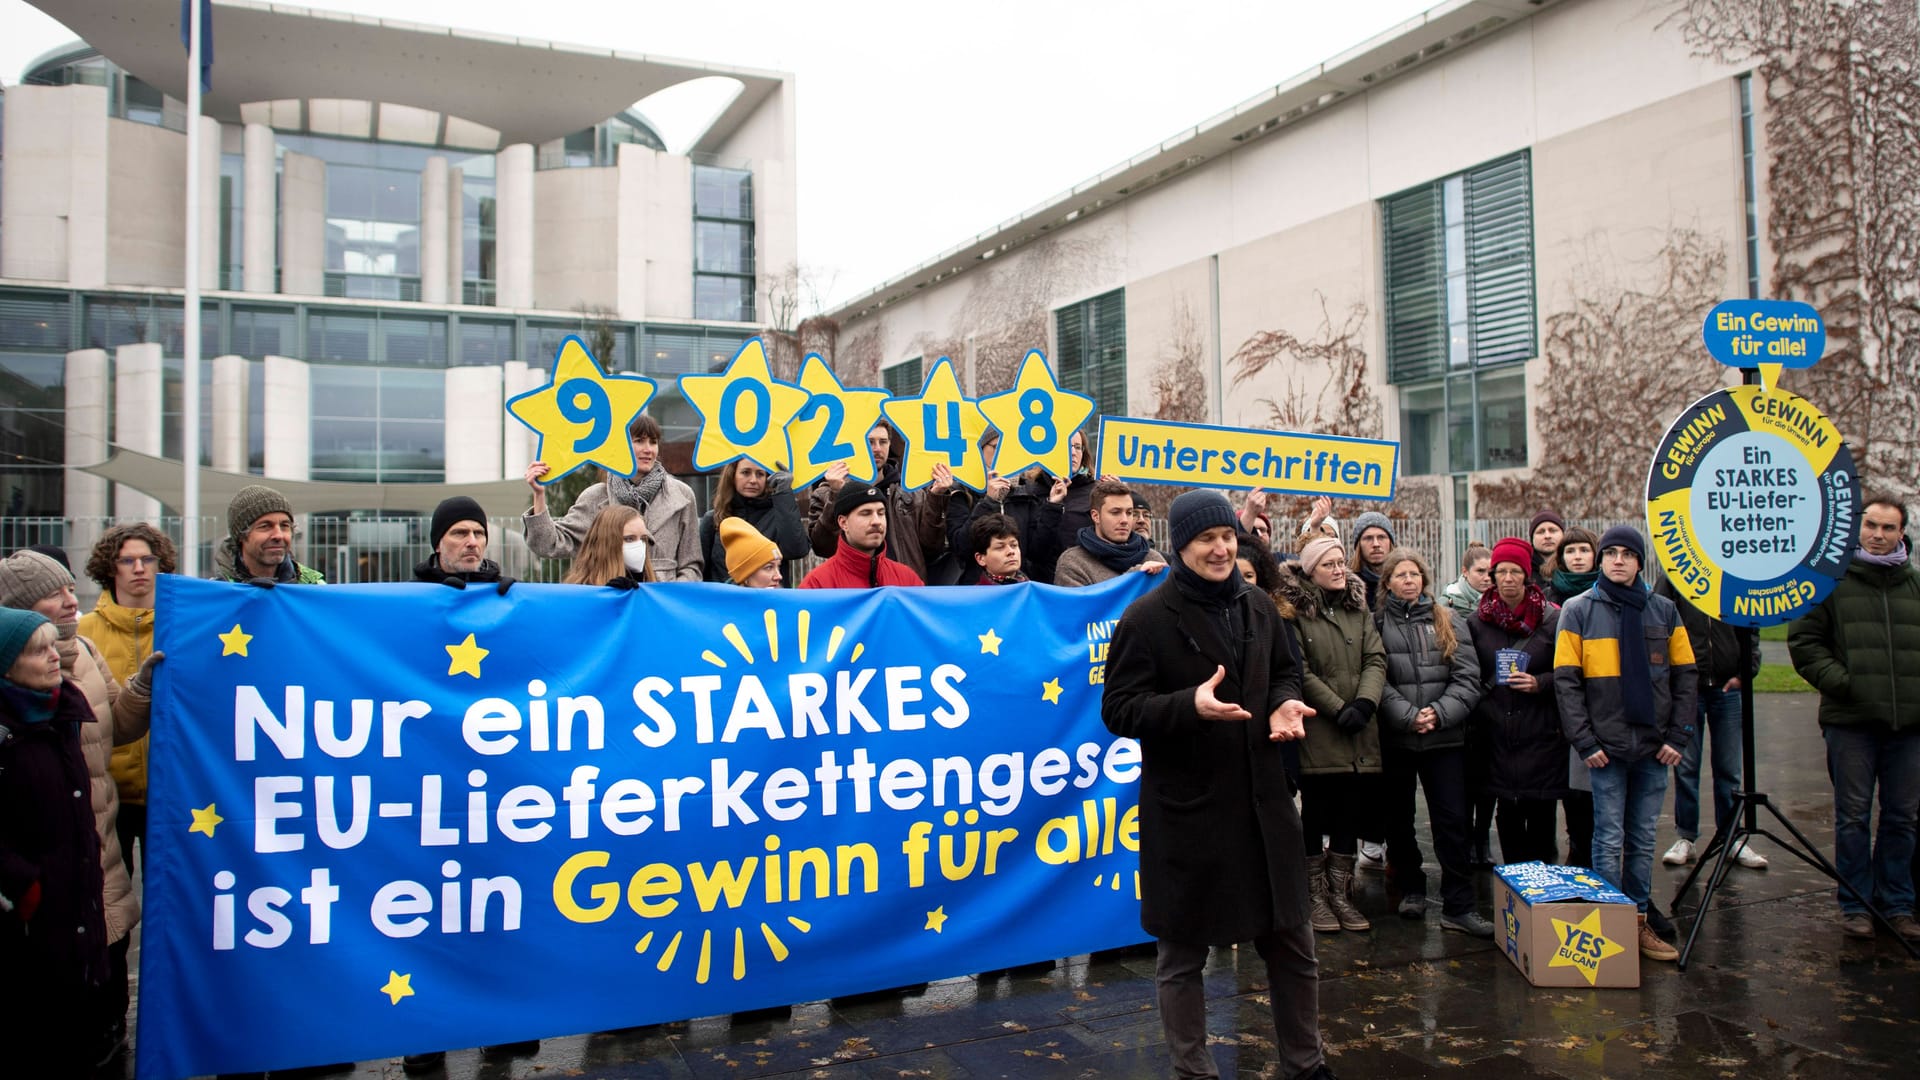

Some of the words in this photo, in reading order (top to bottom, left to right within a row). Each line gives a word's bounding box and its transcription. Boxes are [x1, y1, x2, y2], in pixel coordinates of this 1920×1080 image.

[1716, 312, 1746, 332] Ein
[1750, 312, 1818, 334] Gewinn
[1731, 336, 1762, 356] für
[1767, 340, 1807, 357] alle!
[556, 377, 612, 454] 9
[718, 376, 771, 447] 0
[800, 392, 855, 465] 2
[923, 402, 967, 467] 4
[1018, 388, 1058, 449] 8
[1751, 395, 1829, 448] GEWINN
[1762, 416, 1774, 425] für
[1775, 420, 1786, 430] die
[1787, 425, 1810, 446] Umwelt
[1662, 403, 1727, 480] GEWINN
[1685, 455, 1696, 466] für
[1692, 431, 1716, 455] Europa
[1743, 446, 1771, 465] Ein
[1117, 434, 1382, 487] Unterschriften
[1715, 468, 1798, 488] STARKES
[1823, 471, 1832, 485] für
[1707, 491, 1806, 511] EU-Liefer-
[1825, 470, 1852, 564] GEWINN
[1721, 513, 1795, 532] ketten-
[1809, 500, 1836, 567] Bundesregierung
[1659, 510, 1711, 596] GEWINN
[1678, 515, 1702, 567] Unternehmen
[1721, 535, 1797, 558] gesetz!
[1702, 566, 1712, 577] für
[1786, 578, 1797, 589] für
[1733, 580, 1816, 617] GEWINN
[1748, 584, 1785, 597] Menschen
[235, 685, 432, 761] Nur
[462, 679, 605, 756] ein
[632, 663, 971, 748] STARKES
[254, 736, 1142, 853] EU-Lieferkettengese
[213, 868, 340, 951] ist
[370, 860, 522, 938] ein
[552, 834, 879, 924] Gewinn
[902, 809, 1019, 889] für
[1559, 947, 1572, 960] EU
[1572, 952, 1598, 970] CAN!
[1564, 925, 1605, 959] YES
